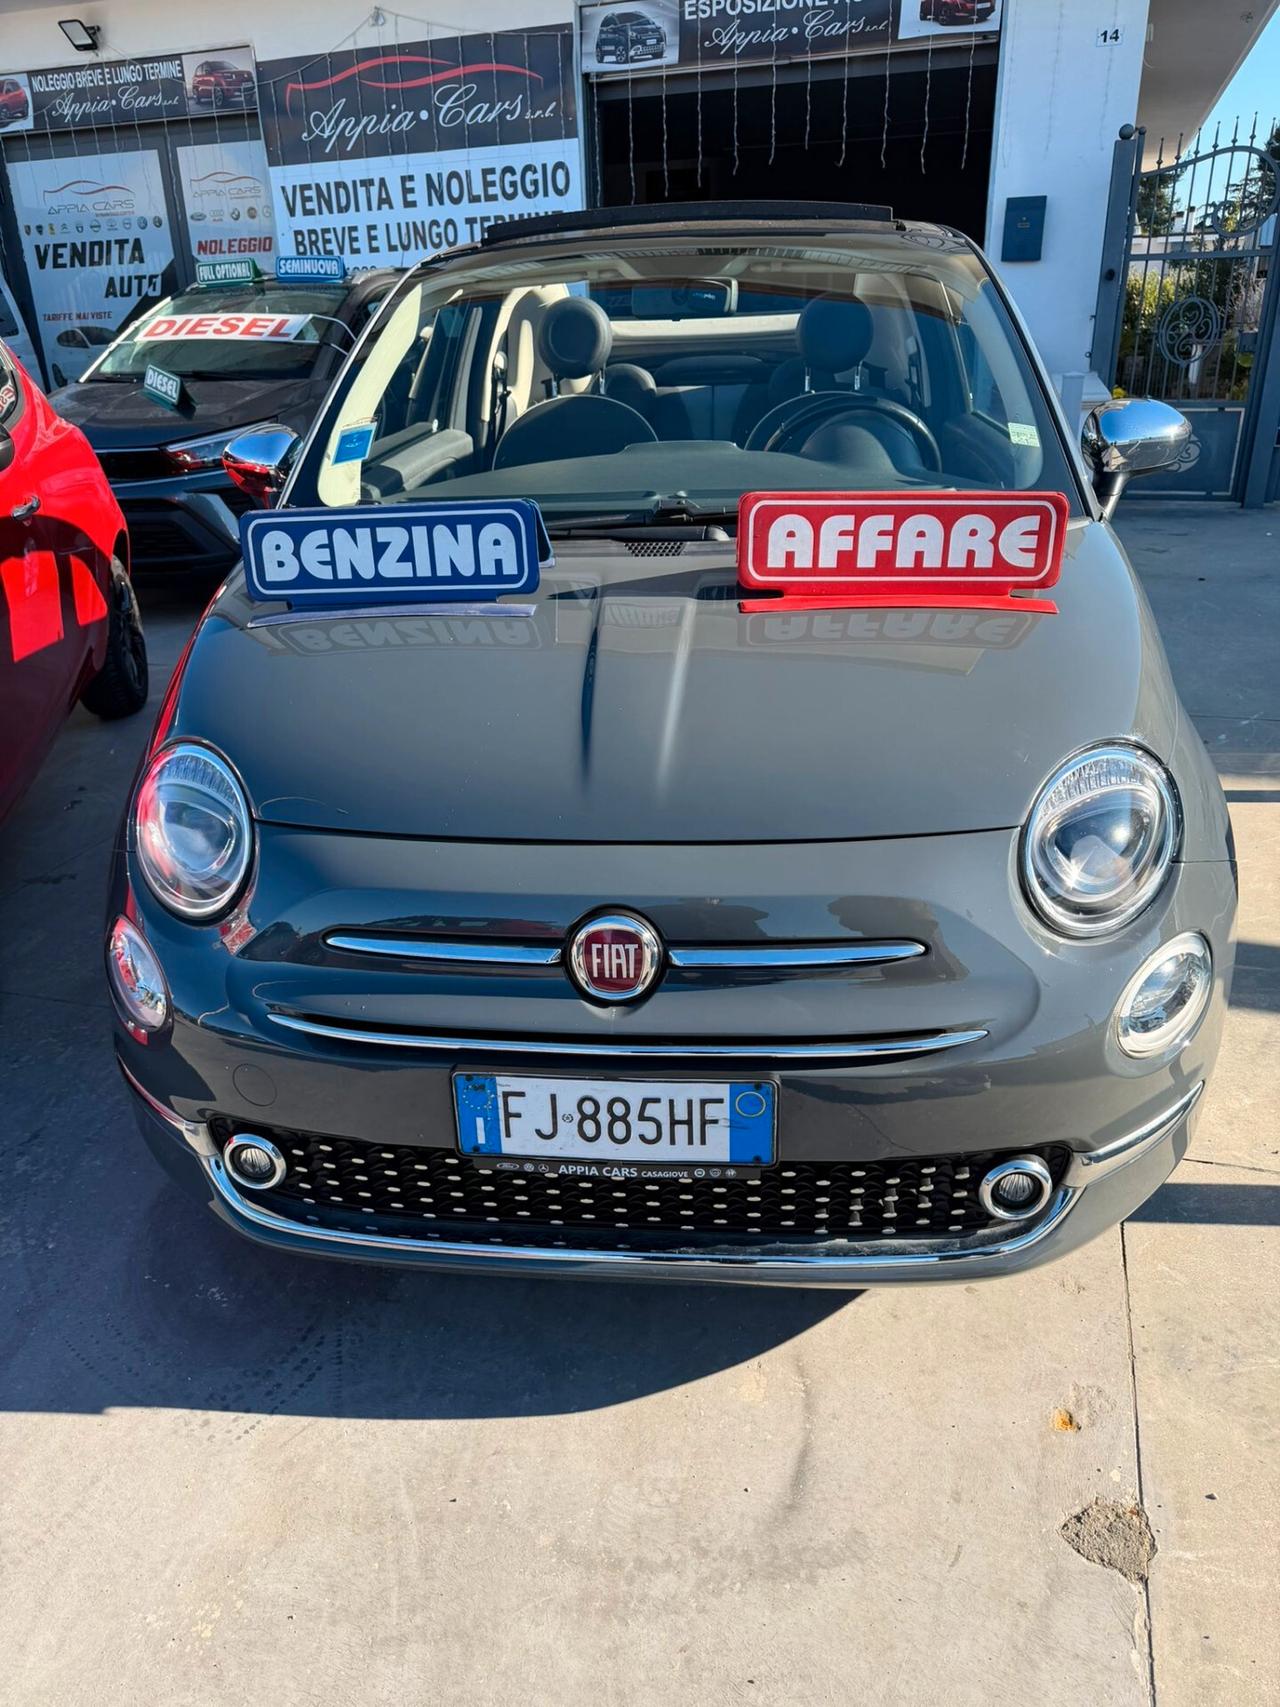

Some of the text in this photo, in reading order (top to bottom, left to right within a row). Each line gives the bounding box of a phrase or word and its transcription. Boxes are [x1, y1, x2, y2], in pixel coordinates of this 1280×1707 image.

[1100, 29, 1120, 43] 14
[31, 60, 183, 93] NOLEGGIO BREVE E LUNGO TERMINE
[281, 161, 571, 218] VENDITA E NOLEGGIO
[48, 203, 90, 215] APPIA
[92, 200, 135, 211] CARS
[197, 236, 273, 255] NOLEGGIO
[293, 225, 361, 256] BREVE
[366, 224, 380, 253] E
[385, 218, 458, 252] LUNGO
[34, 238, 145, 270] VENDITA
[199, 262, 251, 281] FULL OPTIONAL
[279, 259, 340, 275] SEMINUOVA
[43, 312, 73, 322] TARIFFE
[90, 311, 112, 319] VISTE
[143, 316, 294, 338] DIESEL
[147, 369, 177, 398] DIESEL
[261, 522, 518, 582] BENZINA
[767, 513, 1041, 569] AFFARE
[591, 943, 639, 979] FIAT
[558, 1164, 689, 1179] APPIA CARS CASAGIOVE
